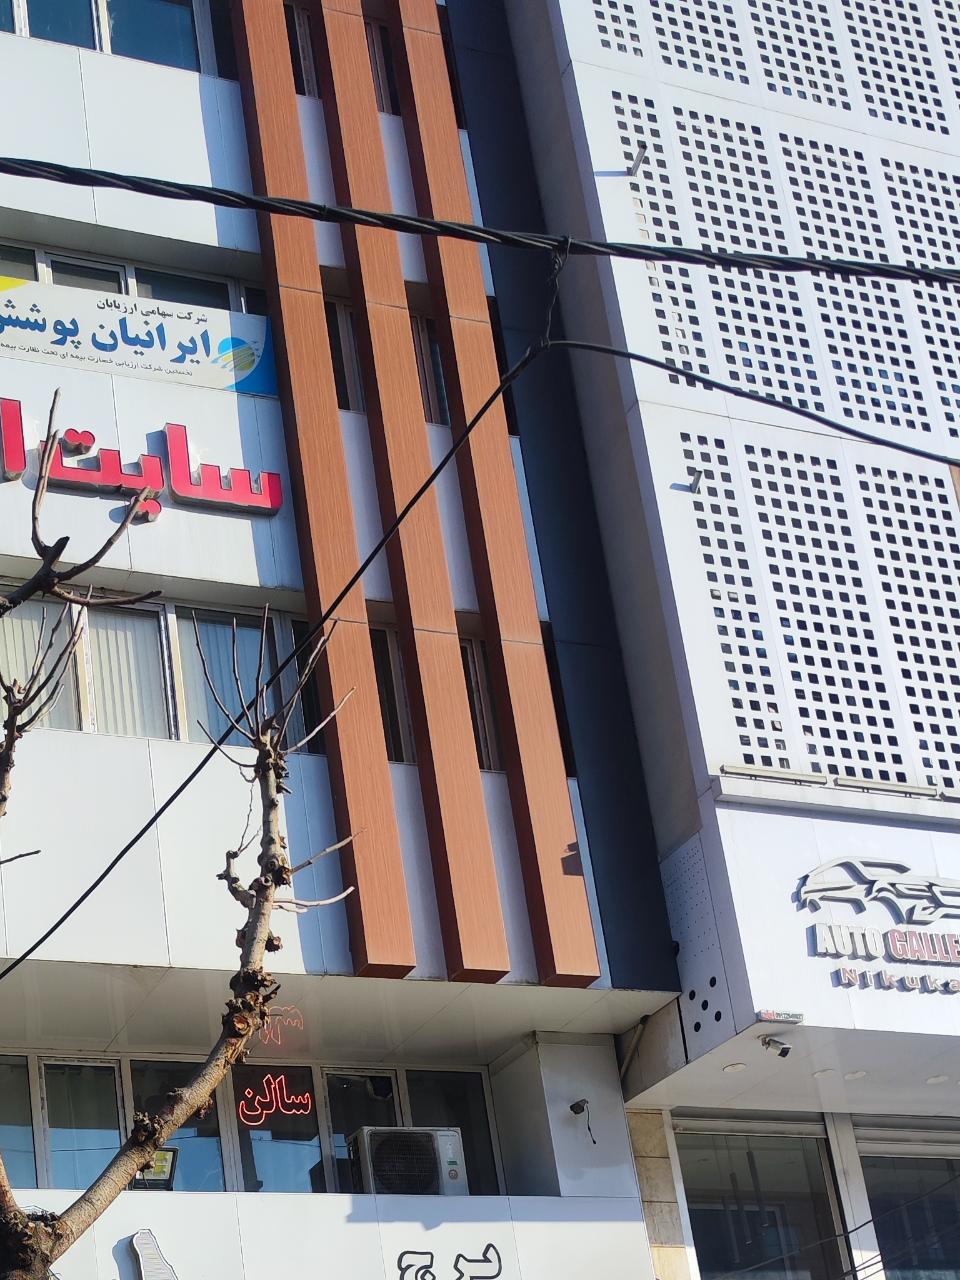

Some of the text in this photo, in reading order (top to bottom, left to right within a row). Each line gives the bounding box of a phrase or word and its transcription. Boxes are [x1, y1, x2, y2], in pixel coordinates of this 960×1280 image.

[96, 298, 208, 325] شرکت سهامی ارزیابان
[91, 316, 211, 364] ایرانیان
[39, 422, 283, 520] سایت
[816, 923, 886, 960] AUTO
[239, 1074, 311, 1126] سالن
